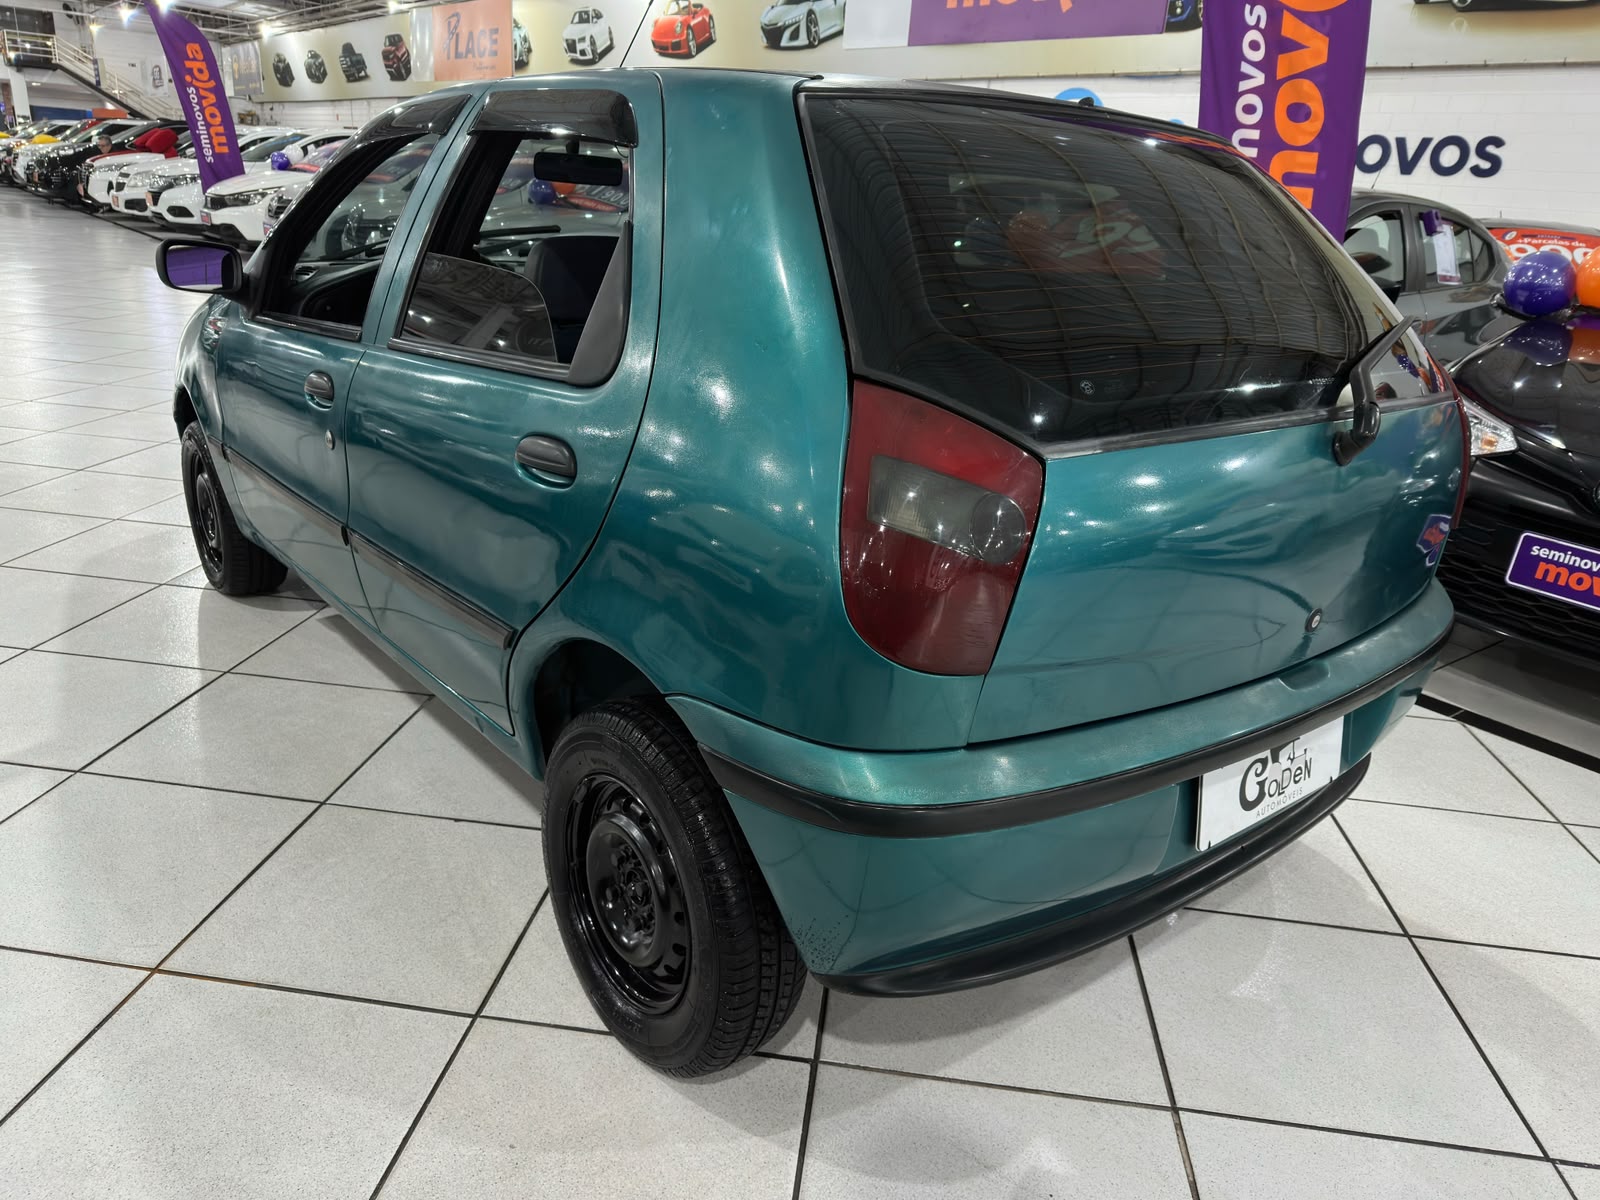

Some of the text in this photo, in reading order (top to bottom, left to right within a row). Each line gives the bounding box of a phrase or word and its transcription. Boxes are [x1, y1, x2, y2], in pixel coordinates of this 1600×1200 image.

[184, 43, 229, 153] movida
[187, 87, 214, 163] seminovos
[1356, 134, 1506, 178] OVOS
